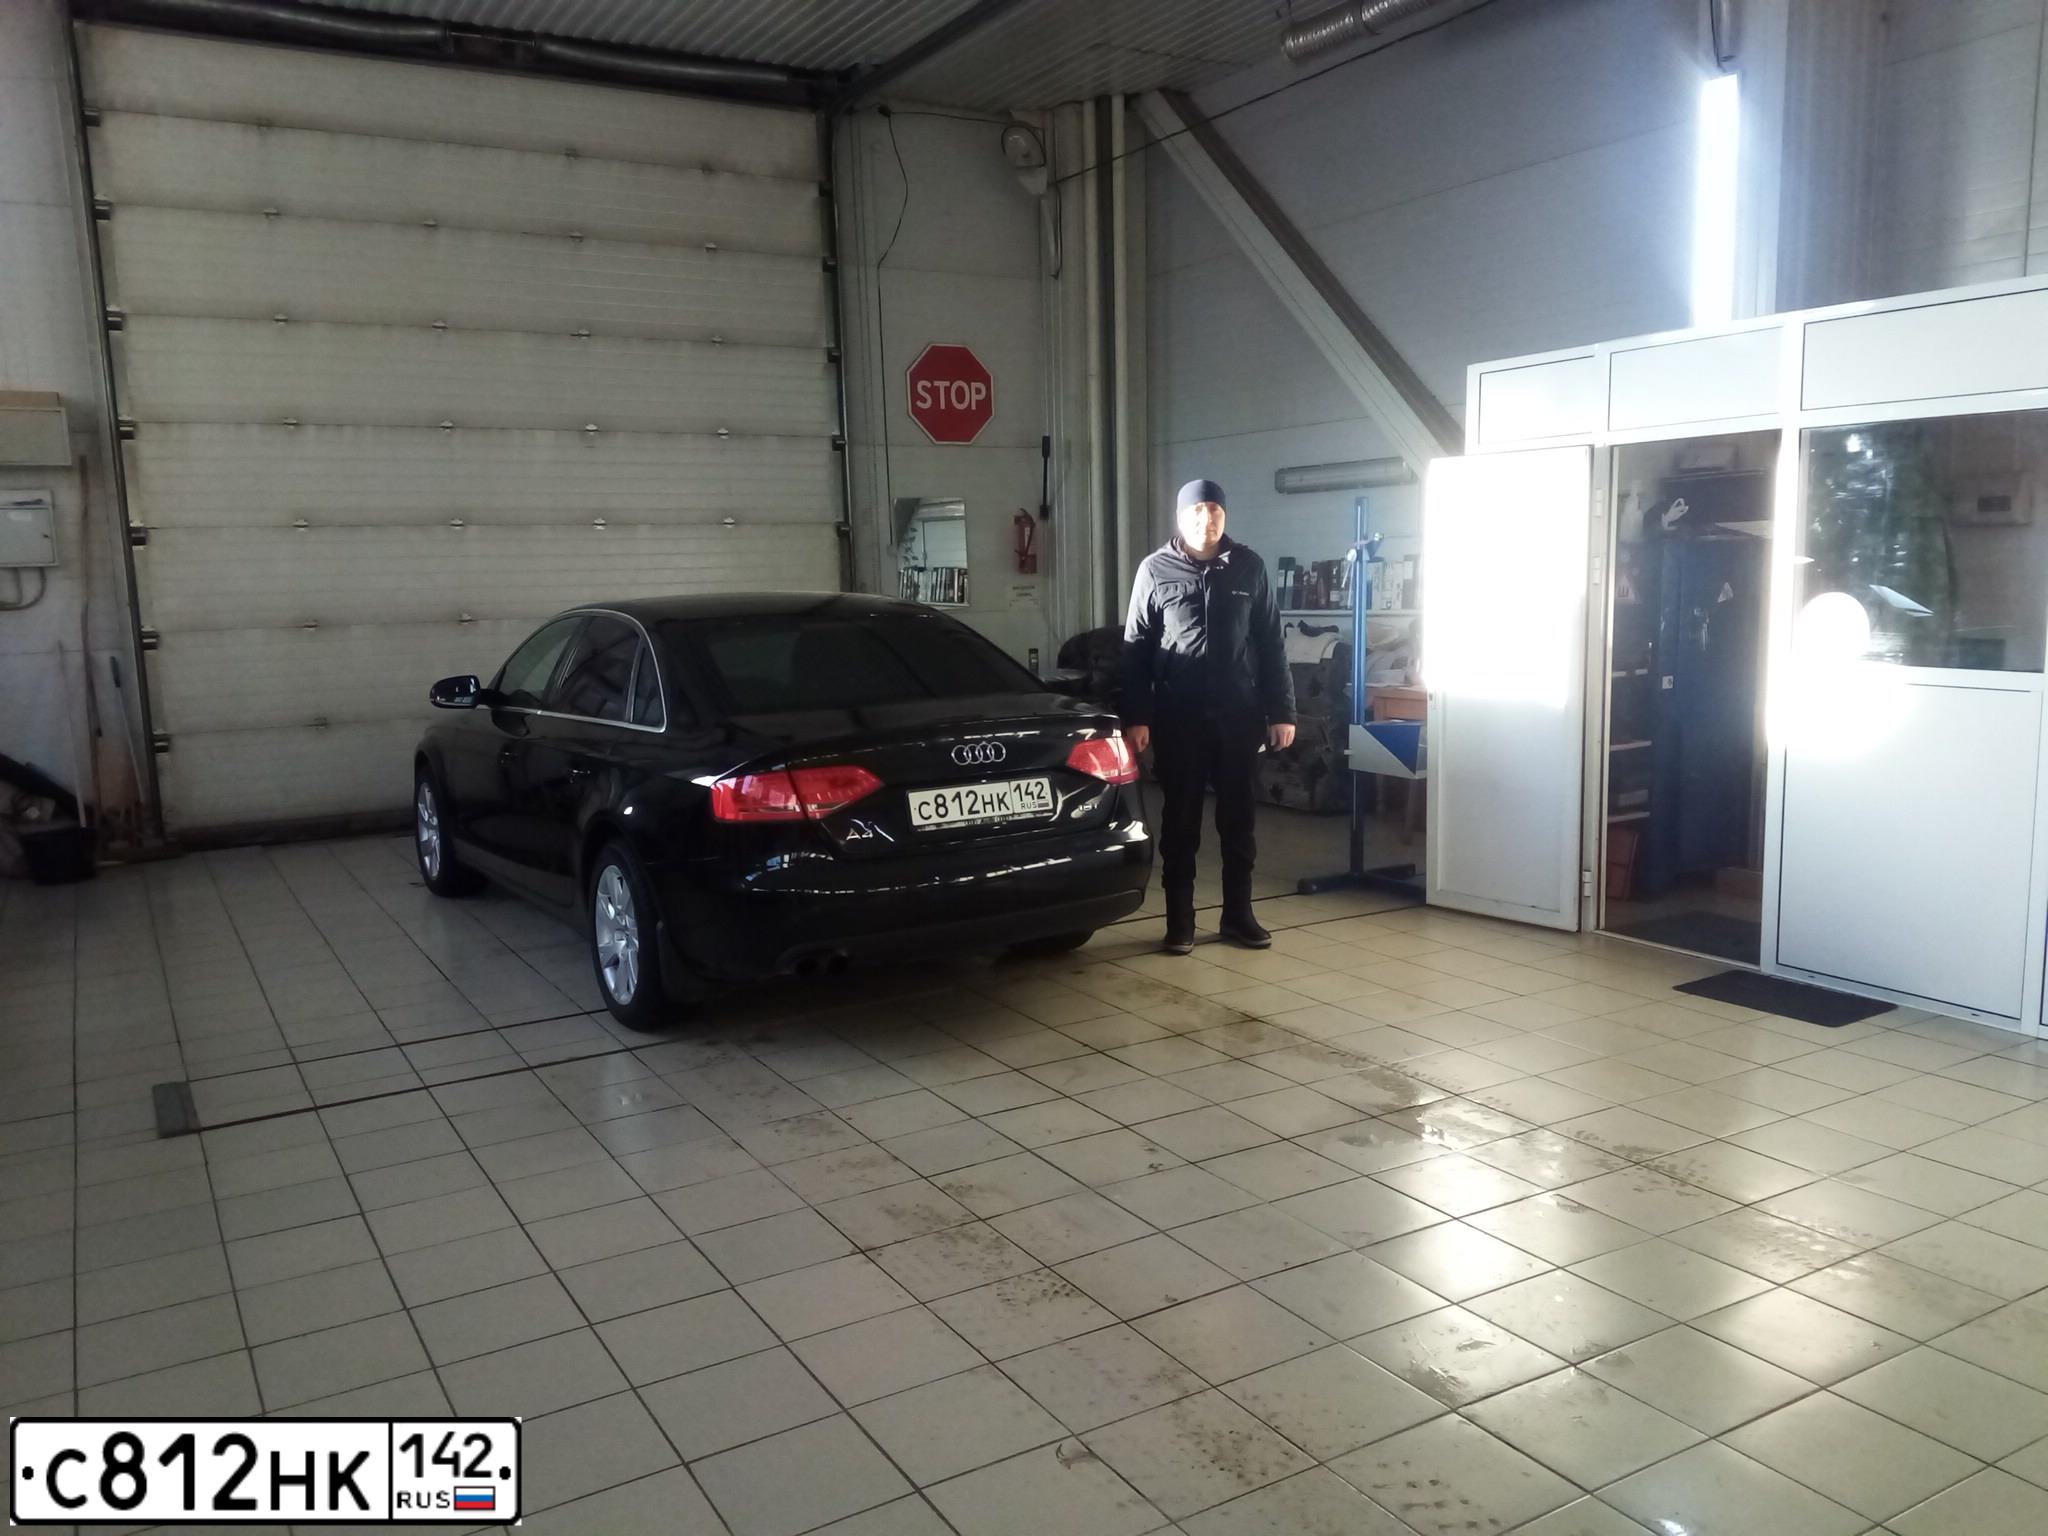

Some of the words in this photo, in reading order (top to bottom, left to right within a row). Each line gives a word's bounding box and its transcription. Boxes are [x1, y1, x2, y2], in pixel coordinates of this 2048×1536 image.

[915, 380, 986, 411] STOP
[1013, 781, 1046, 802] 142
[1020, 801, 1038, 810] RUS
[846, 827, 874, 841] A4
